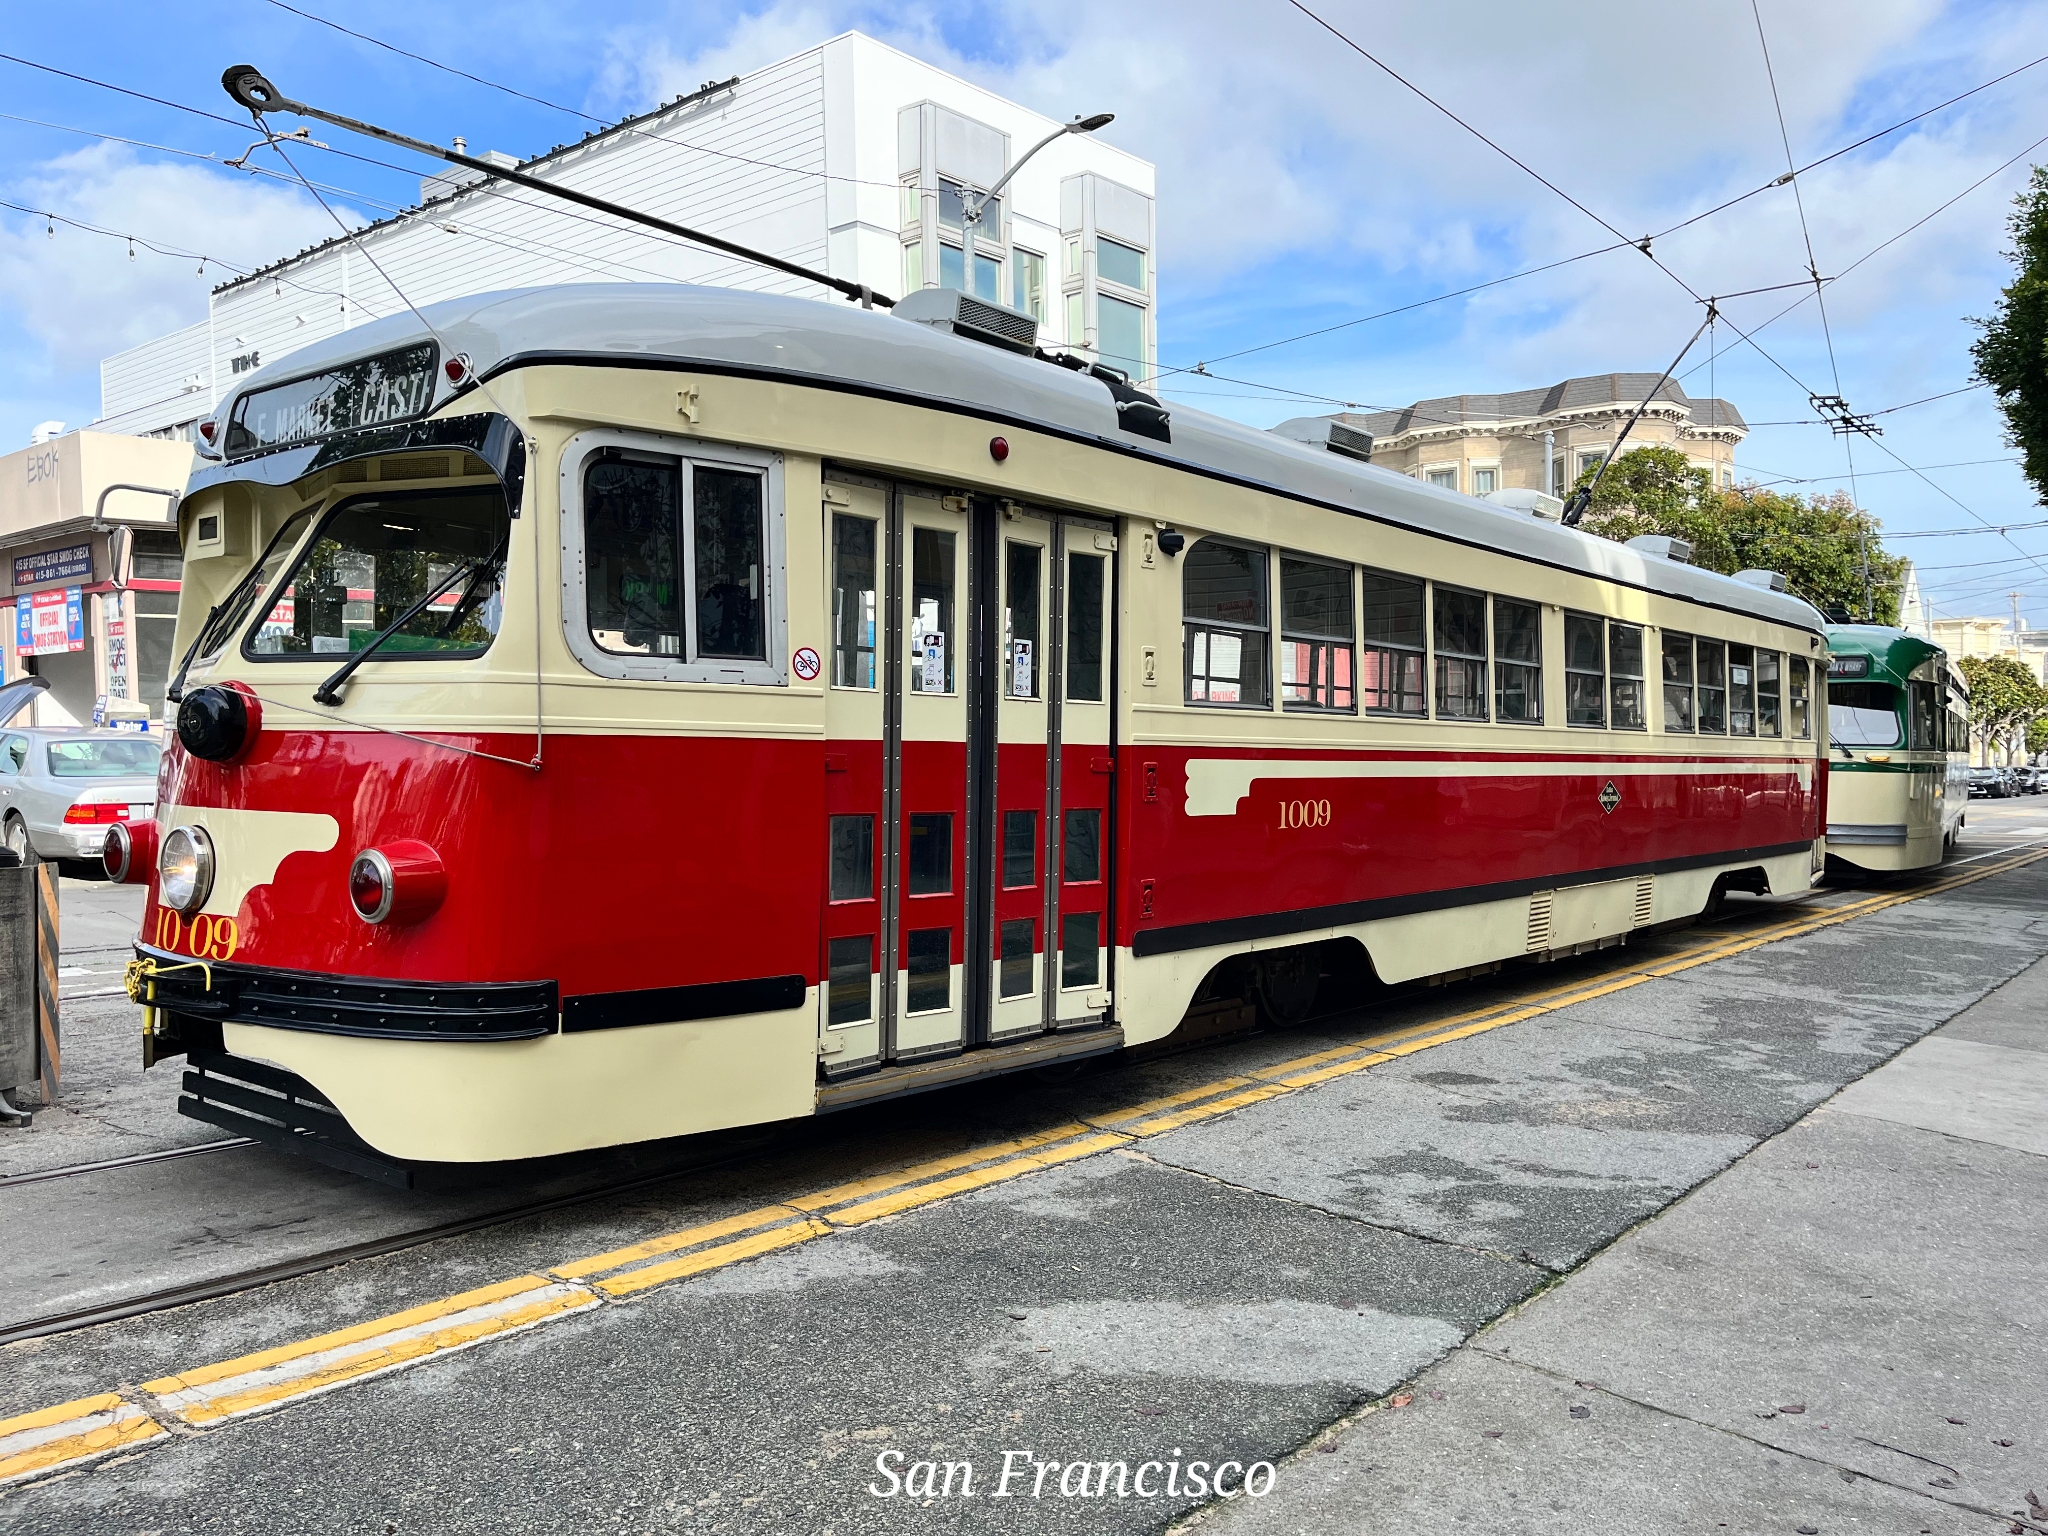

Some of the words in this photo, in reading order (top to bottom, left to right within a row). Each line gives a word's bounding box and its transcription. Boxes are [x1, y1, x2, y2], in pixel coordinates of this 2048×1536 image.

[275, 396, 335, 444] MARKET
[23, 558, 29, 570] SF
[29, 554, 47, 569] OFFICIAL
[47, 551, 59, 566] STAR
[59, 549, 73, 563] SMOG
[73, 545, 90, 560] CHECK
[24, 573, 34, 583] STAR
[1277, 799, 1331, 829] 1009
